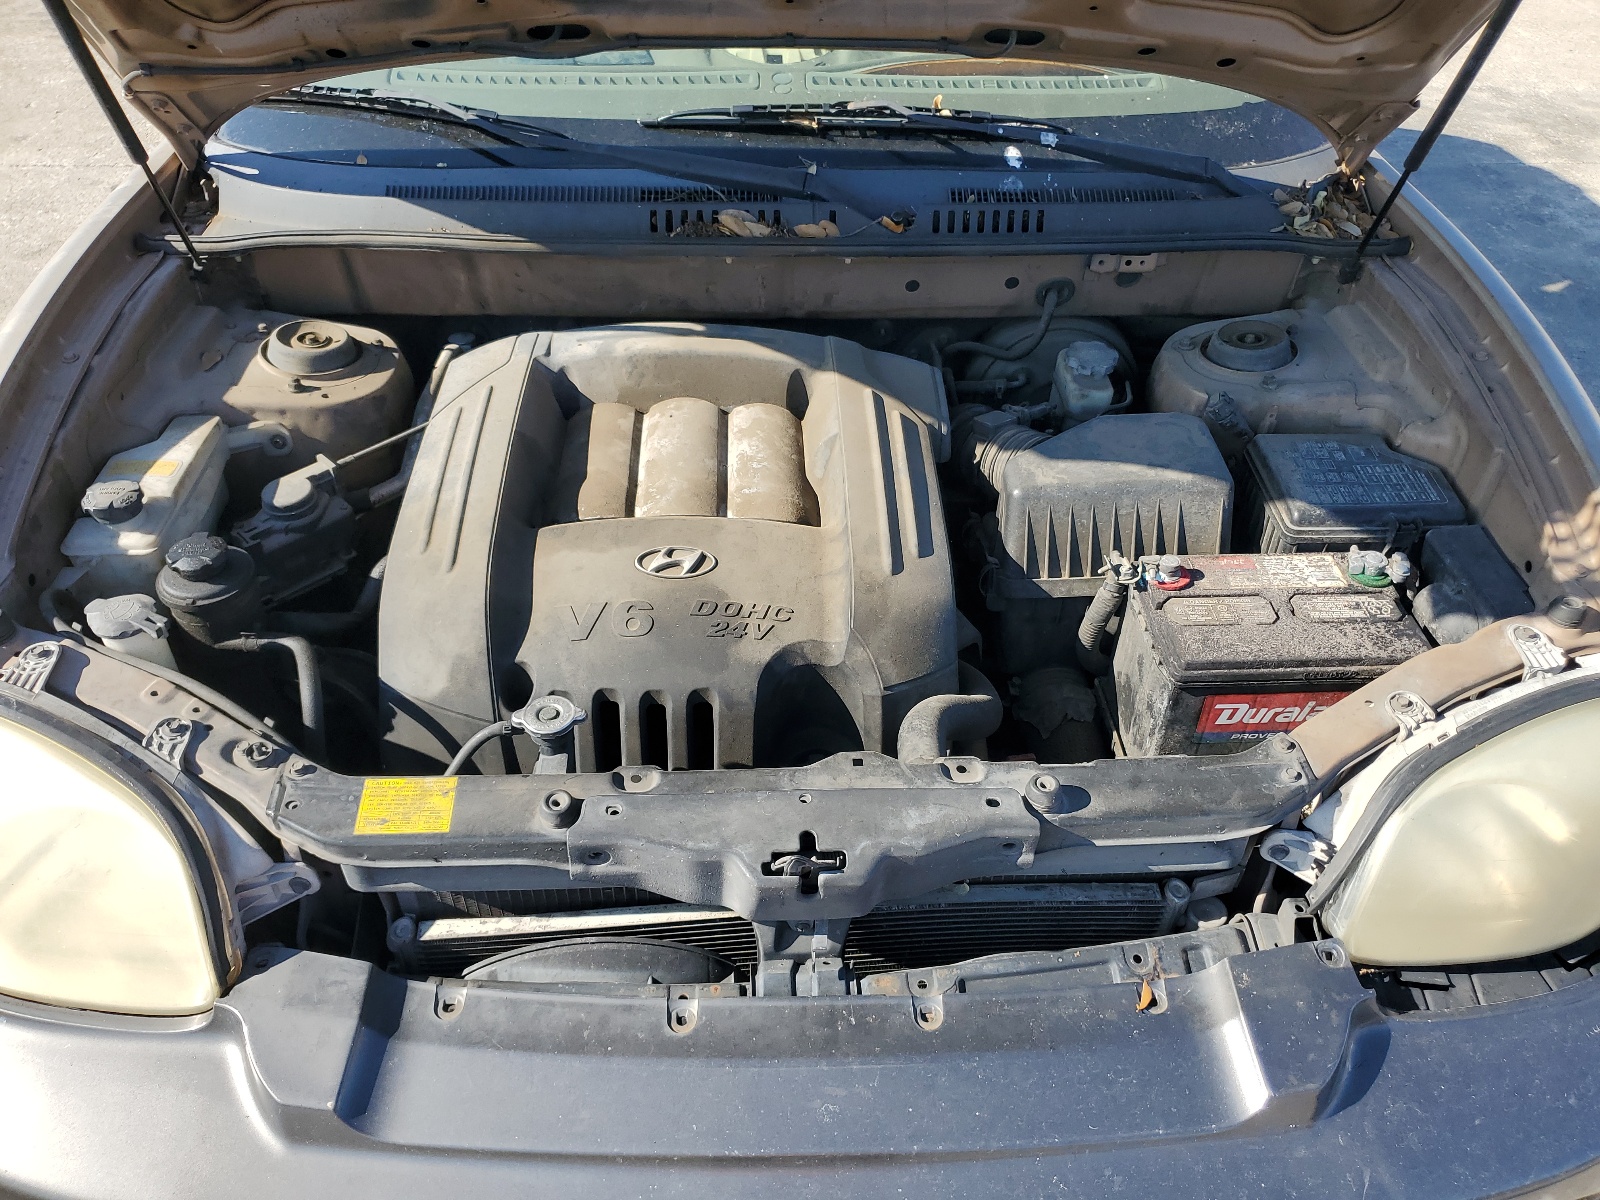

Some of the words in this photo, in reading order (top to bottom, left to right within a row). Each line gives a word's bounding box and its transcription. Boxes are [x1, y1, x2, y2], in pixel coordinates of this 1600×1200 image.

[560, 599, 655, 642] V6
[690, 599, 795, 622] DOHC
[706, 620, 775, 641] 24V
